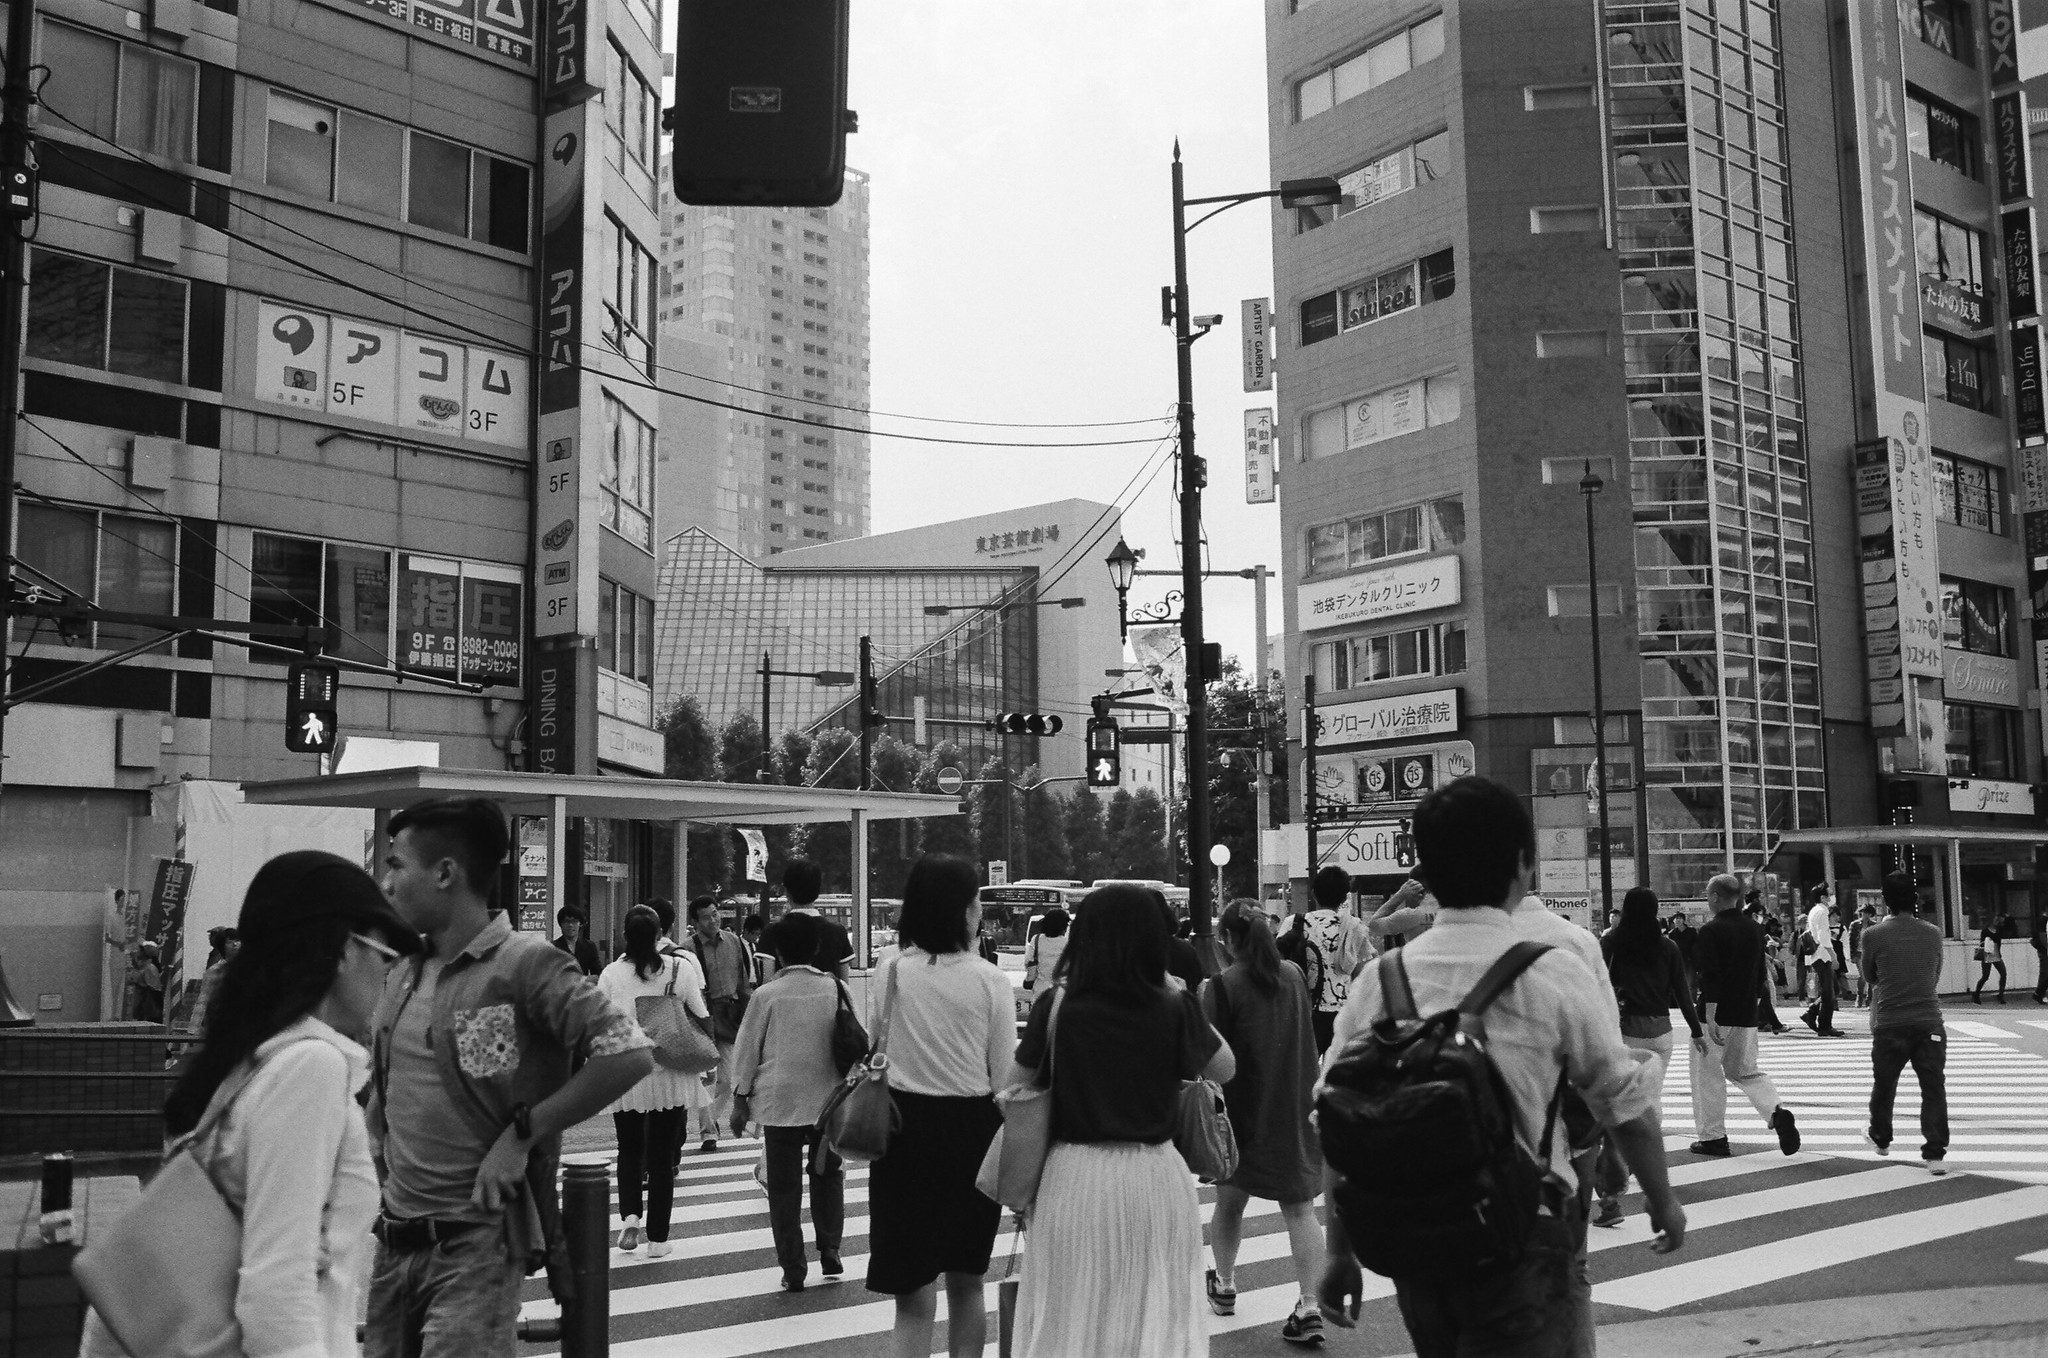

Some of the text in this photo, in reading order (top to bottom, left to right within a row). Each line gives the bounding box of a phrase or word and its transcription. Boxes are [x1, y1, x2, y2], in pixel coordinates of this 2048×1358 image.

[487, 33, 523, 58] 営業中
[1875, 76, 1911, 363] ハウスメイト
[2014, 229, 2030, 297] たかの友梨
[549, 268, 574, 372] アコム
[1253, 303, 1263, 336] ARTIST
[1926, 284, 1981, 323] たかの友梨
[346, 329, 513, 396] アコム
[1254, 340, 1264, 379] GARDEN
[332, 382, 365, 405] 5F
[469, 409, 499, 432] 3F
[549, 472, 570, 493] 5F
[548, 567, 567, 579] ATM
[411, 576, 514, 636] 指圧
[547, 597, 568, 617] 3F
[1312, 577, 1441, 615] 池袋デンタルクリニック
[1335, 600, 1416, 621] IKEBUKURO DENTAL CLINIC
[412, 631, 518, 659] 9F 3982-0008
[540, 668, 557, 737] DINING
[1332, 701, 1450, 735] グローバル治療院
[1976, 786, 2010, 811] Prize
